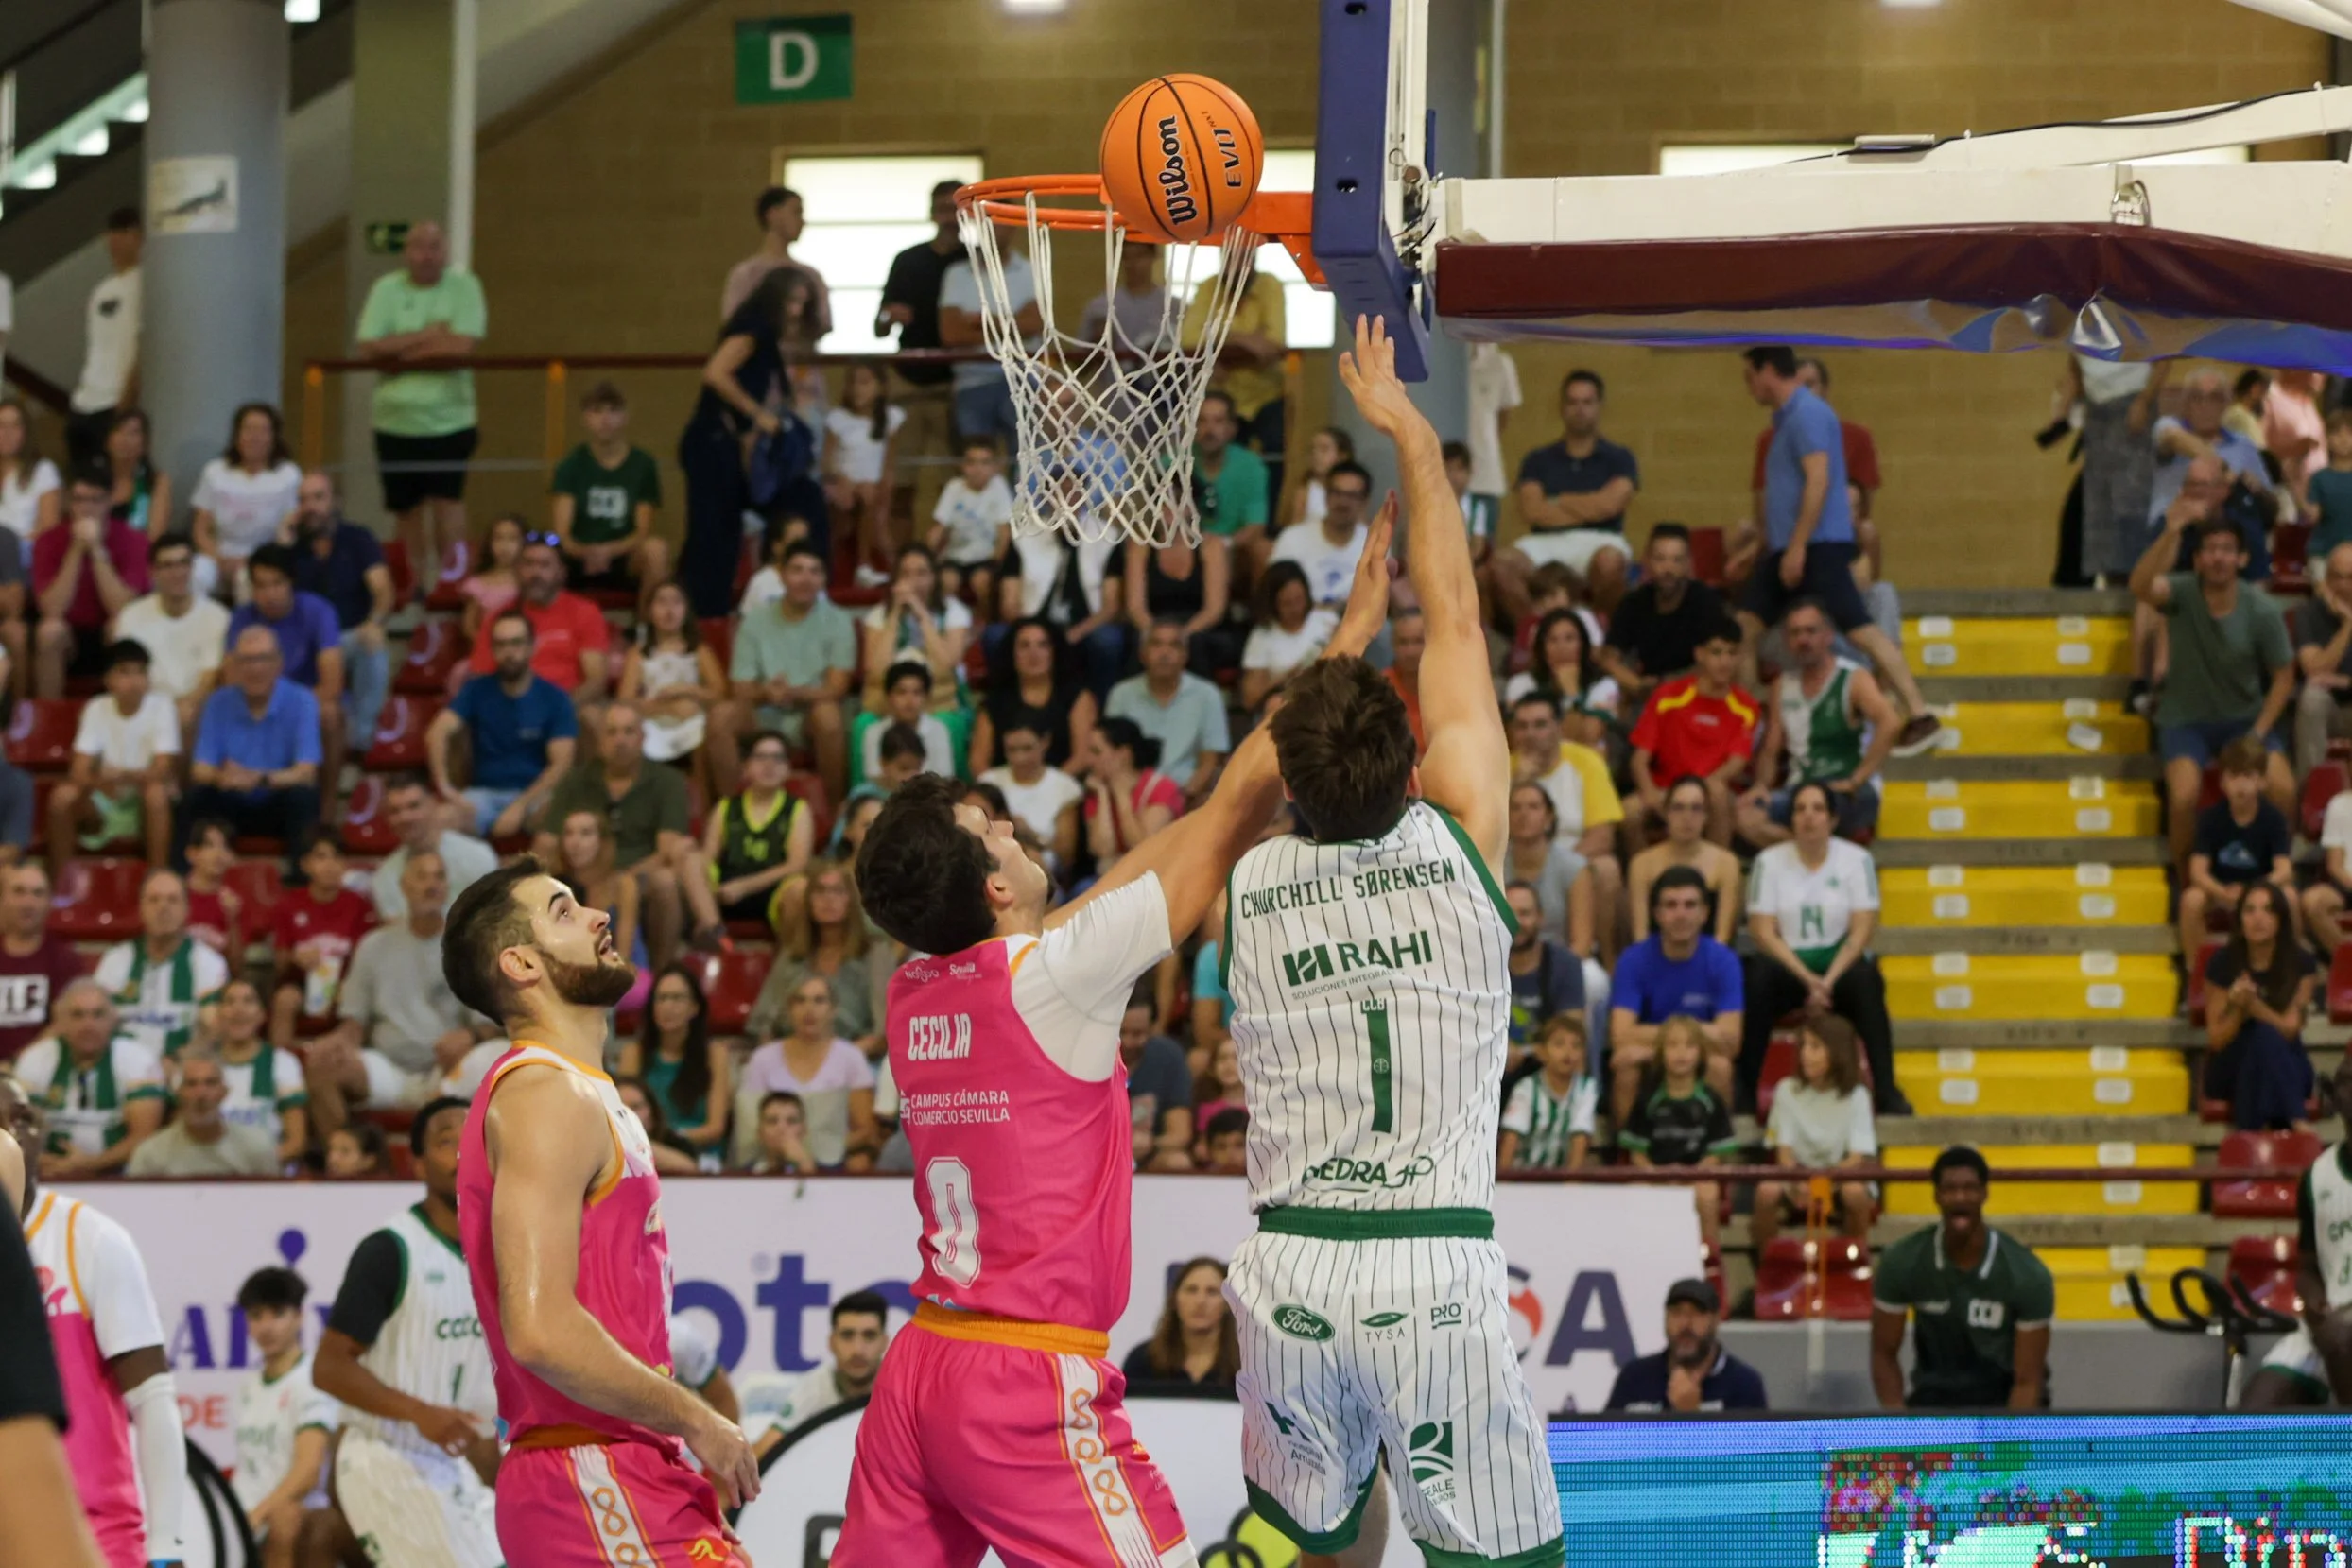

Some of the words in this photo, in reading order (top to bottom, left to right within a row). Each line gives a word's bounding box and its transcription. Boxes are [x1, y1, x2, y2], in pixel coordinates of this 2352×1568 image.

[769, 31, 818, 90] D
[1157, 116, 1198, 226] Wilson
[1240, 876, 1343, 920] CHURCHILL
[1353, 857, 1456, 899] SØRENSEN
[1336, 929, 1433, 973] RAHI
[1291, 978, 1348, 1001] SOLUCIONES
[908, 1012, 972, 1061] CECILIA
[910, 1092, 951, 1109] CAMPUS
[953, 1088, 1010, 1107] CÁMARA
[912, 1109, 959, 1126] COMERCIO
[960, 1107, 1011, 1125] SEVILLA
[926, 1156, 982, 1290] 0
[1282, 1308, 1323, 1338] Ford
[1365, 1326, 1406, 1344] TYSA
